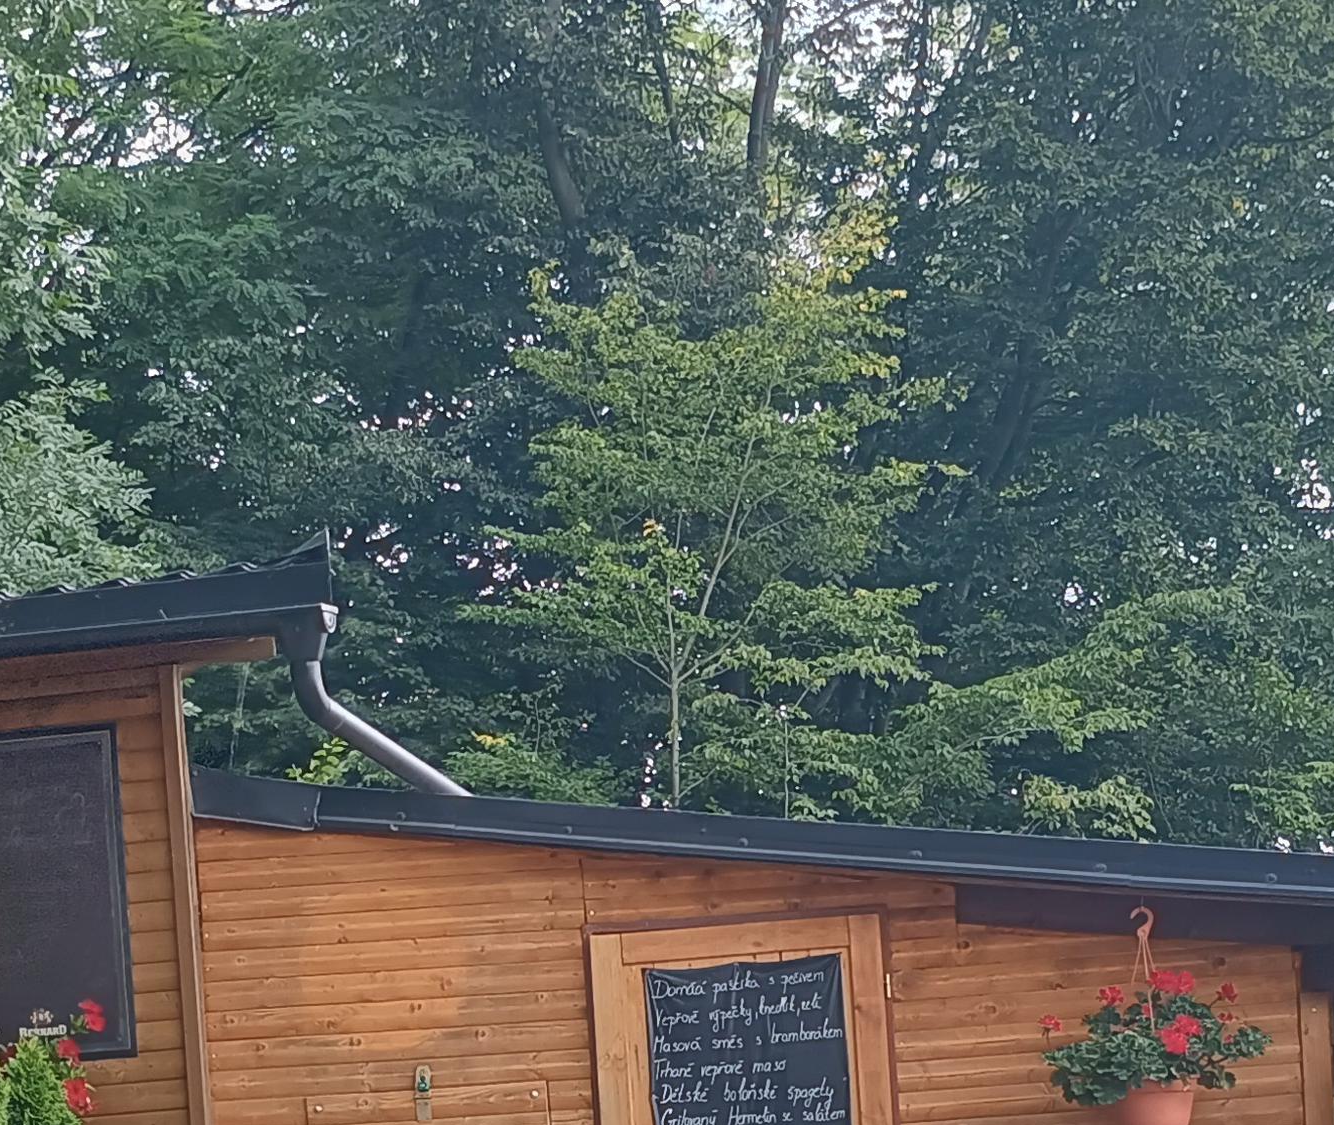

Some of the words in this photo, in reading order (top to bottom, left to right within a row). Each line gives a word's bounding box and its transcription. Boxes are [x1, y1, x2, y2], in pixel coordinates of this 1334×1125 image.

[712, 970, 760, 1004] paštika
[768, 976, 775, 985] s
[781, 971, 824, 994] pečivem
[18, 1024, 67, 1037] BERNARD
[656, 1008, 700, 1035] Vepřové
[653, 1035, 702, 1054] Masová
[712, 1033, 744, 1050] směs
[756, 1036, 762, 1045] s
[770, 1017, 843, 1044] bramborákem
[654, 1058, 696, 1081] Trhané
[701, 1060, 745, 1085] vepřové
[752, 1060, 787, 1075] maso
[660, 1081, 709, 1104] Dětské
[723, 1077, 778, 1102] boloňské
[787, 1076, 834, 1108] špagety
[782, 1112, 793, 1122] se
[802, 1103, 846, 1122] salátem
